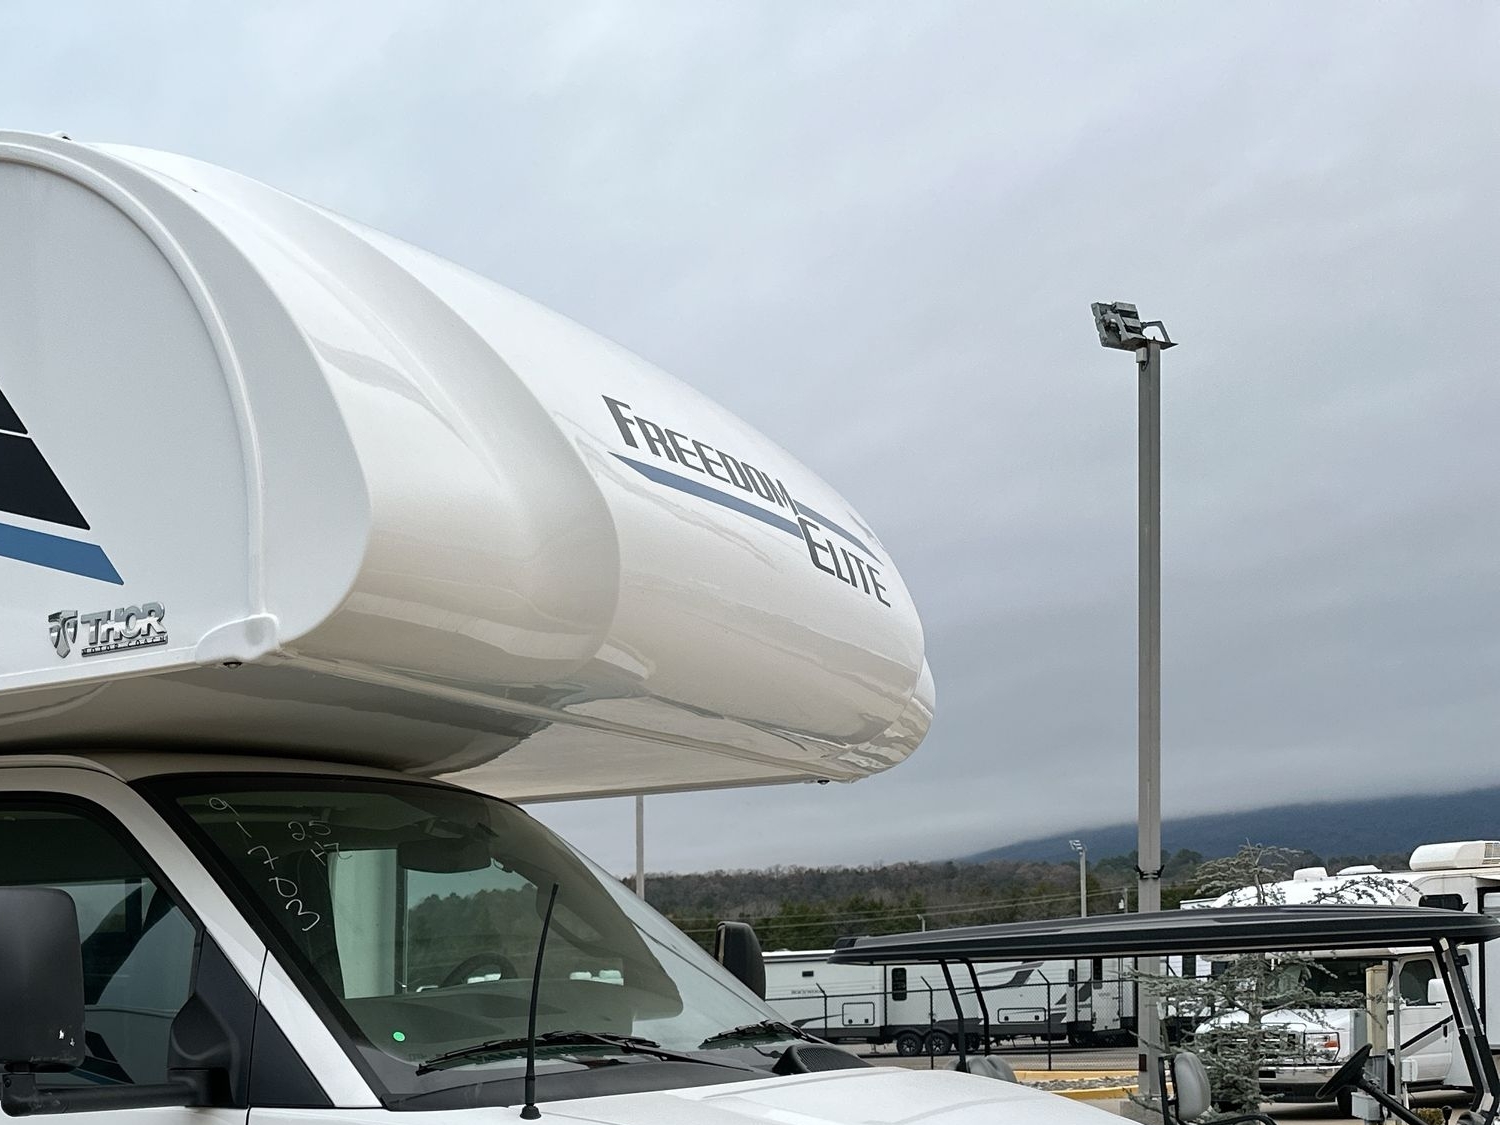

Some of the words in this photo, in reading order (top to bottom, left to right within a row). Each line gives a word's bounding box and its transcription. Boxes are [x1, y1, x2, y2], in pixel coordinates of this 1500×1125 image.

[601, 394, 798, 516] FREEDOM
[798, 516, 891, 608] ELITE
[80, 601, 167, 646] THOR
